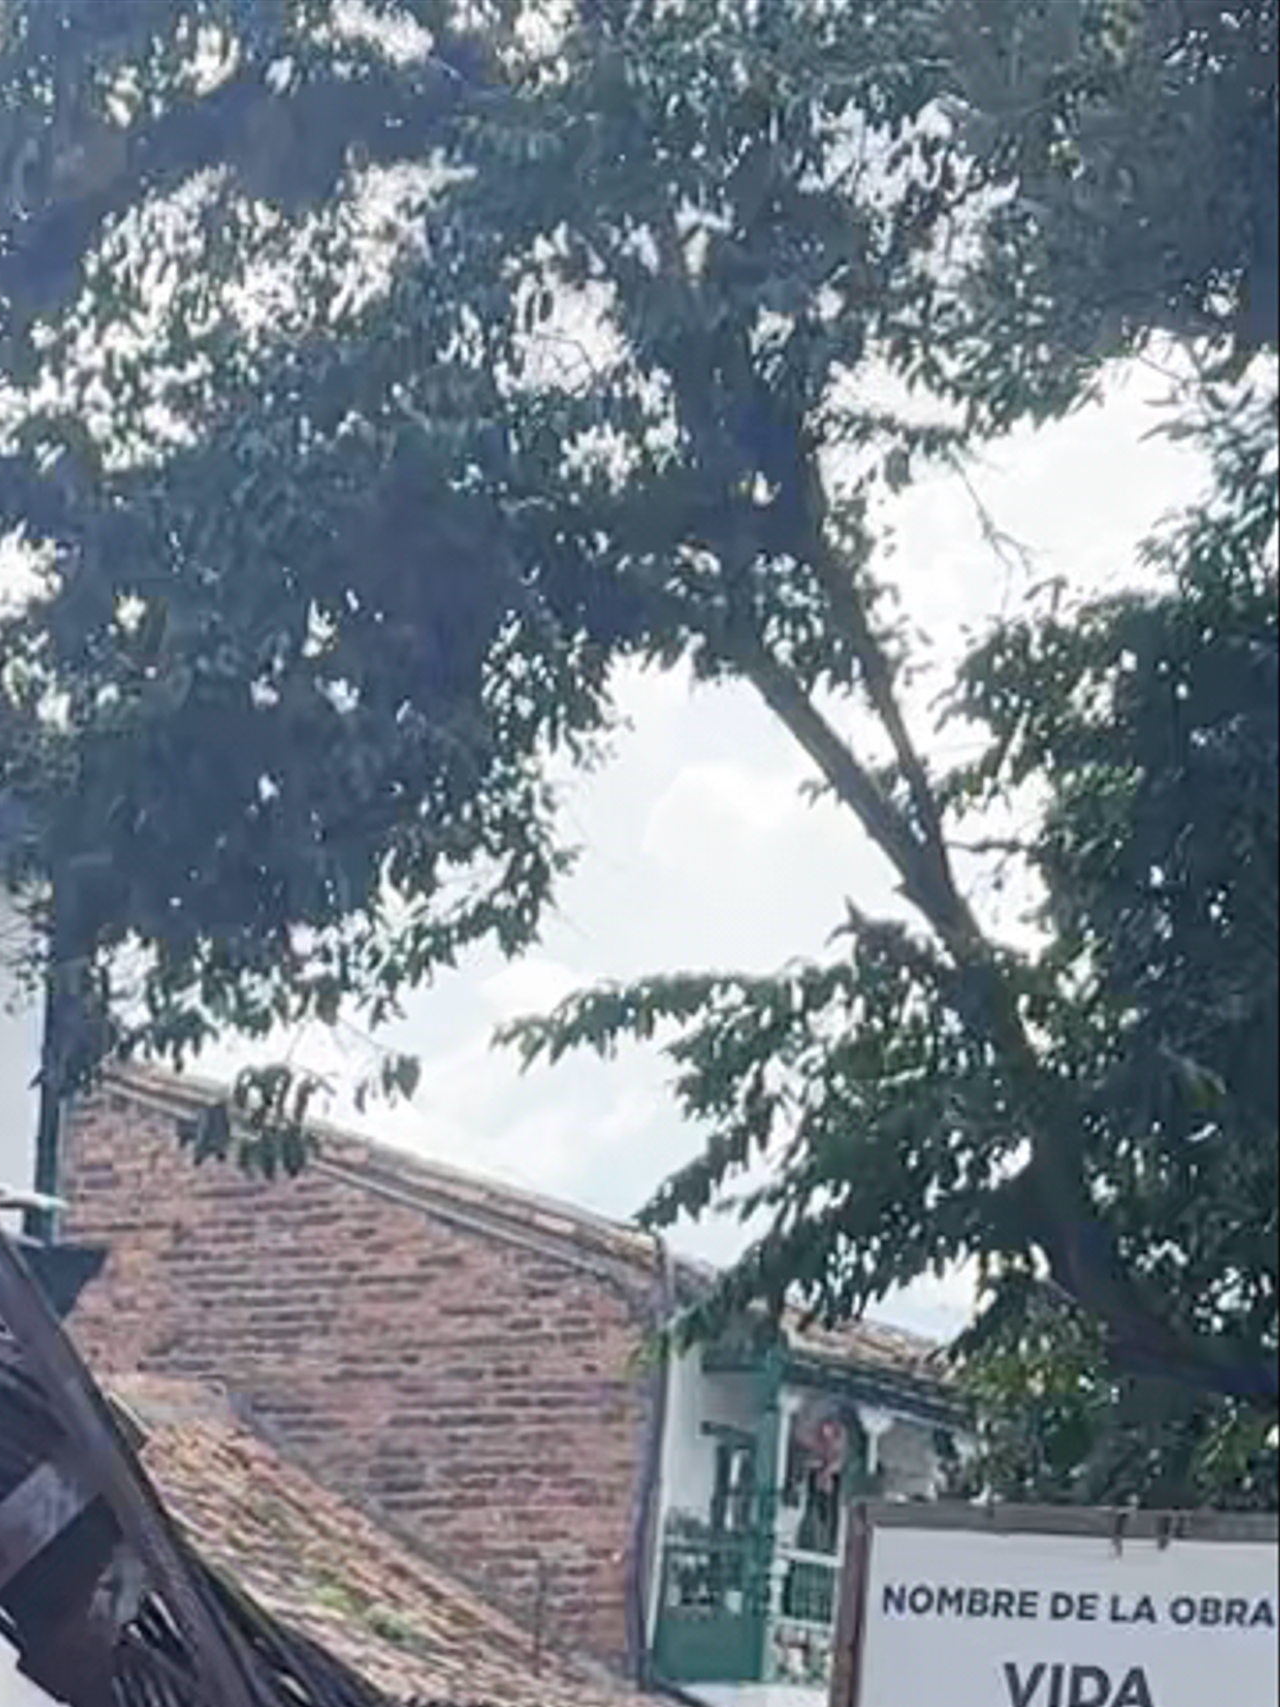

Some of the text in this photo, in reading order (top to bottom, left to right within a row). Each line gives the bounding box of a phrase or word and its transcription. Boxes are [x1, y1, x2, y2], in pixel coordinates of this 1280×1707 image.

[882, 1586, 1275, 1627] NOMBRE DE LA OBRA
